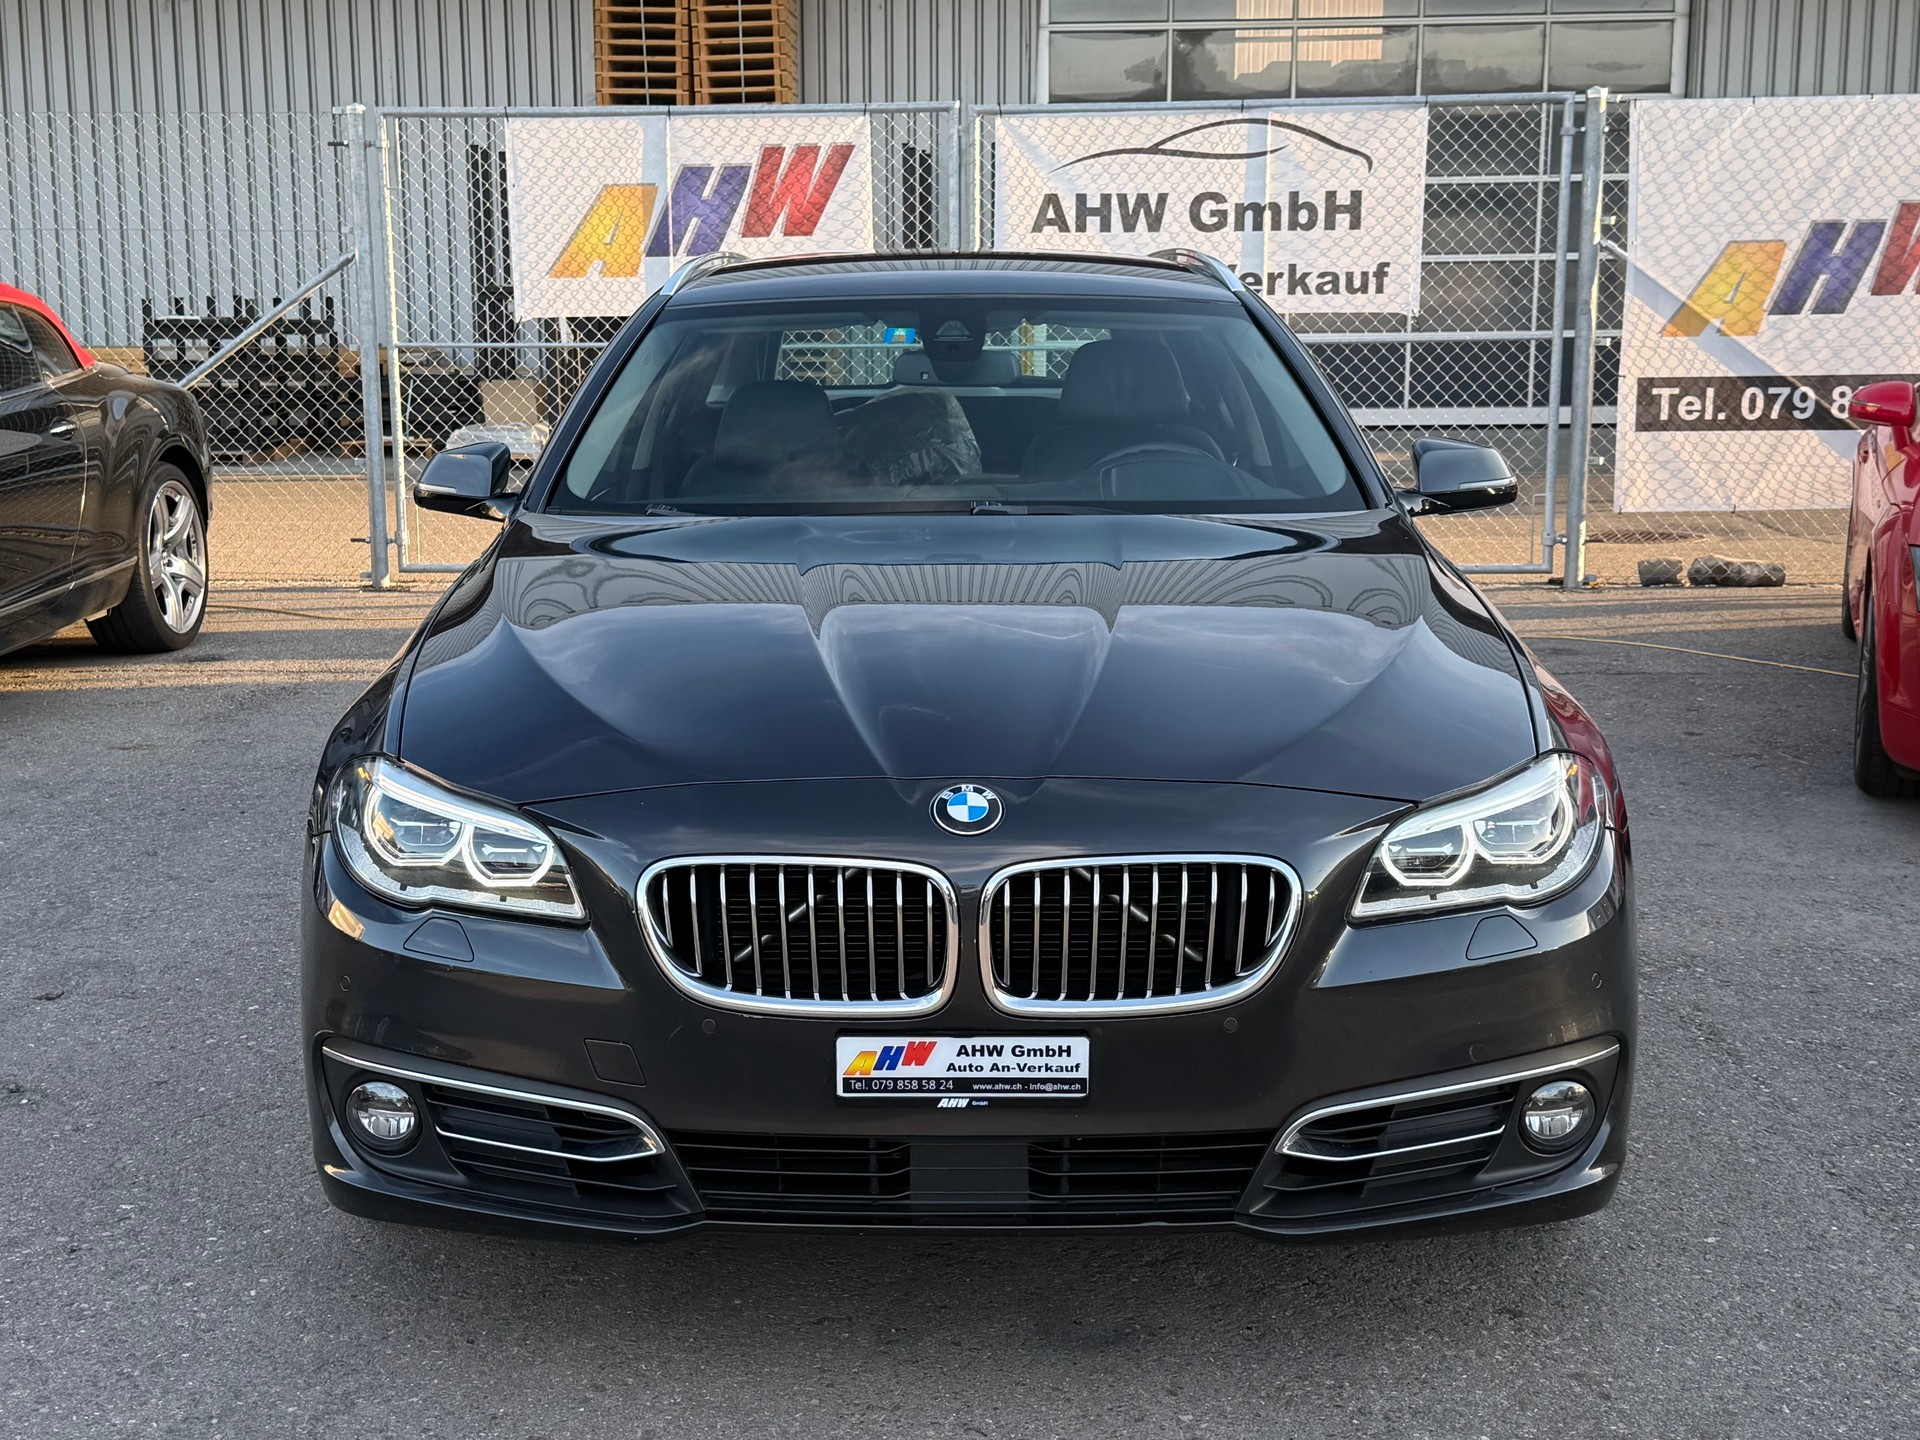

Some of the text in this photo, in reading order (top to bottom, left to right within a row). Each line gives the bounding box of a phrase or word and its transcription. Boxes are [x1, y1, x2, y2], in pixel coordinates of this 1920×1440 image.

[547, 142, 856, 278] AHW
[1031, 189, 1363, 233] AHW GmbH
[1652, 387, 1726, 421] Tel.
[1740, 385, 1816, 420] 079
[940, 784, 996, 800] BMW
[843, 1041, 938, 1076] AHW
[956, 1044, 1072, 1058] AHW GmbH
[946, 1062, 1082, 1073] Auto An-Verkauf
[849, 1079, 954, 1090] Tel. 079 858 58 24
[972, 1082, 1023, 1091] www.ahw.ch
[936, 1098, 970, 1108] AHW
